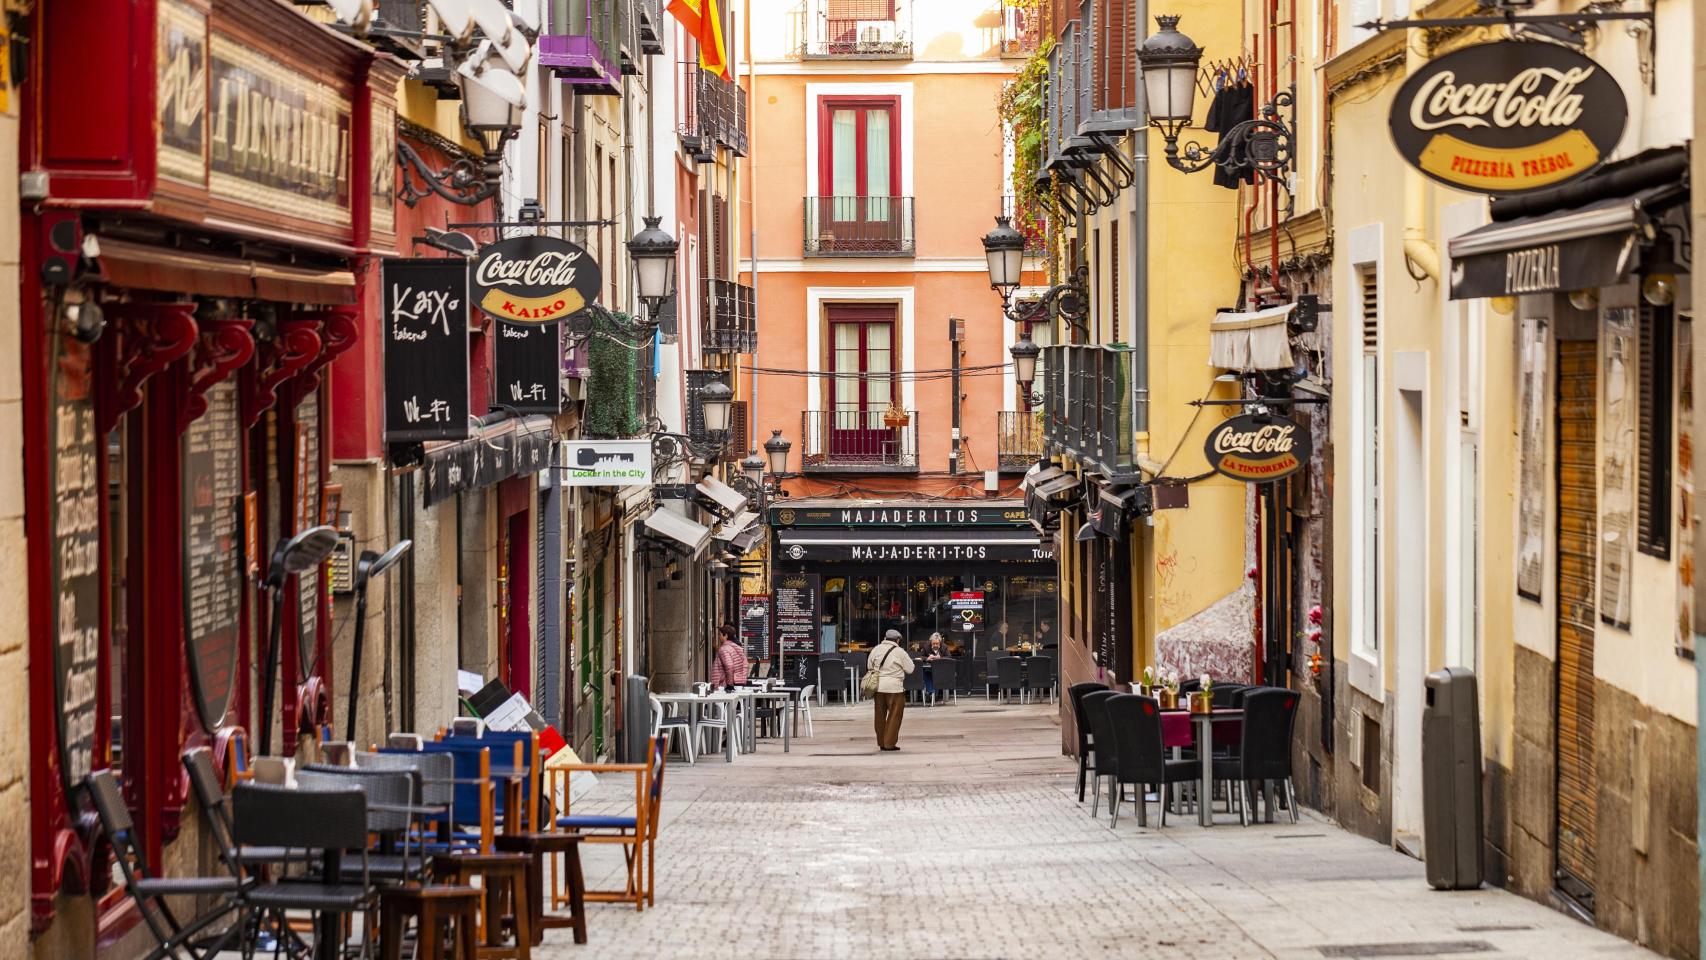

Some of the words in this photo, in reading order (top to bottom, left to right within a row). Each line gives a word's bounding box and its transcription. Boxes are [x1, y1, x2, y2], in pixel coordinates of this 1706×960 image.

[1410, 65, 1595, 130] Coca-Cola
[1451, 156, 1515, 177] PIZZERÍA
[476, 251, 583, 287] Coca-Cola
[1505, 245, 1560, 294] PIZZERIA
[392, 283, 460, 337] Kaixo
[502, 299, 567, 318] KAIXO
[393, 324, 427, 341] taberna
[502, 324, 529, 340] taberna
[1214, 424, 1296, 454] Coca-Cola
[572, 469, 602, 478] Locker
[603, 469, 610, 478] in
[613, 469, 627, 478] the
[629, 469, 646, 479] City
[1223, 458, 1237, 471] LA
[1003, 510, 1025, 519] CAFÉ
